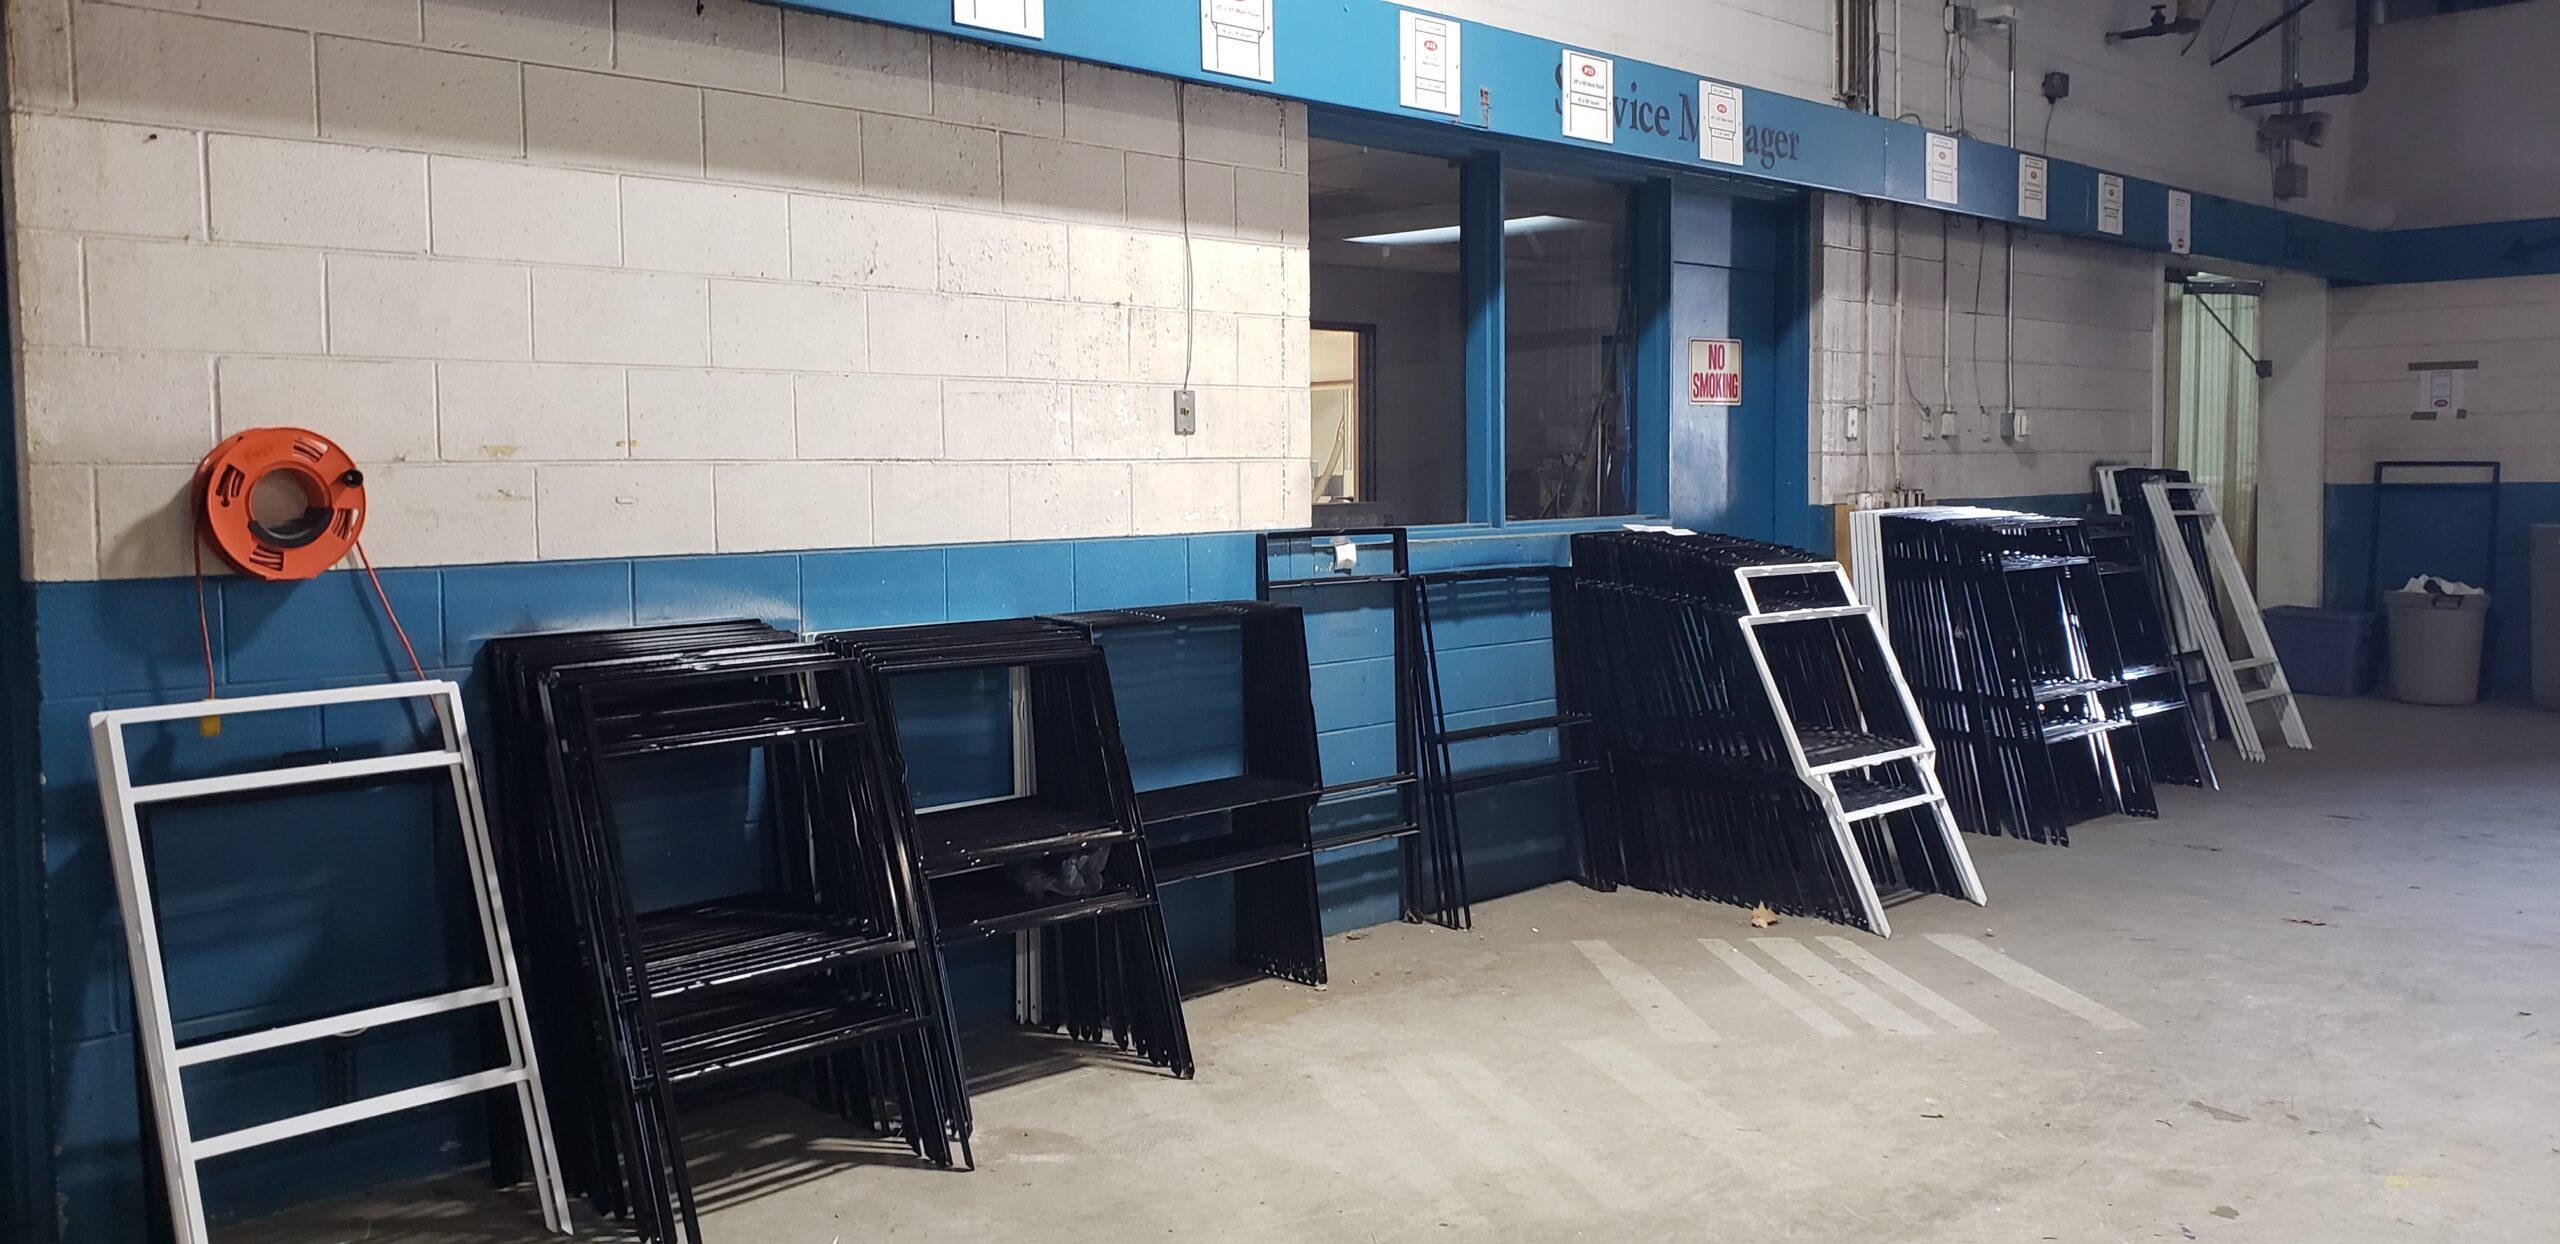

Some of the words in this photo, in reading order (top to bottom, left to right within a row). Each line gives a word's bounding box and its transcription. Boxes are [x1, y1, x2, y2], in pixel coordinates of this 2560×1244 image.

[1554, 63, 1671, 137] vice
[1678, 92, 1800, 170] Mager
[1708, 343, 1725, 370] NO
[1692, 372, 1738, 399] SMOKING
